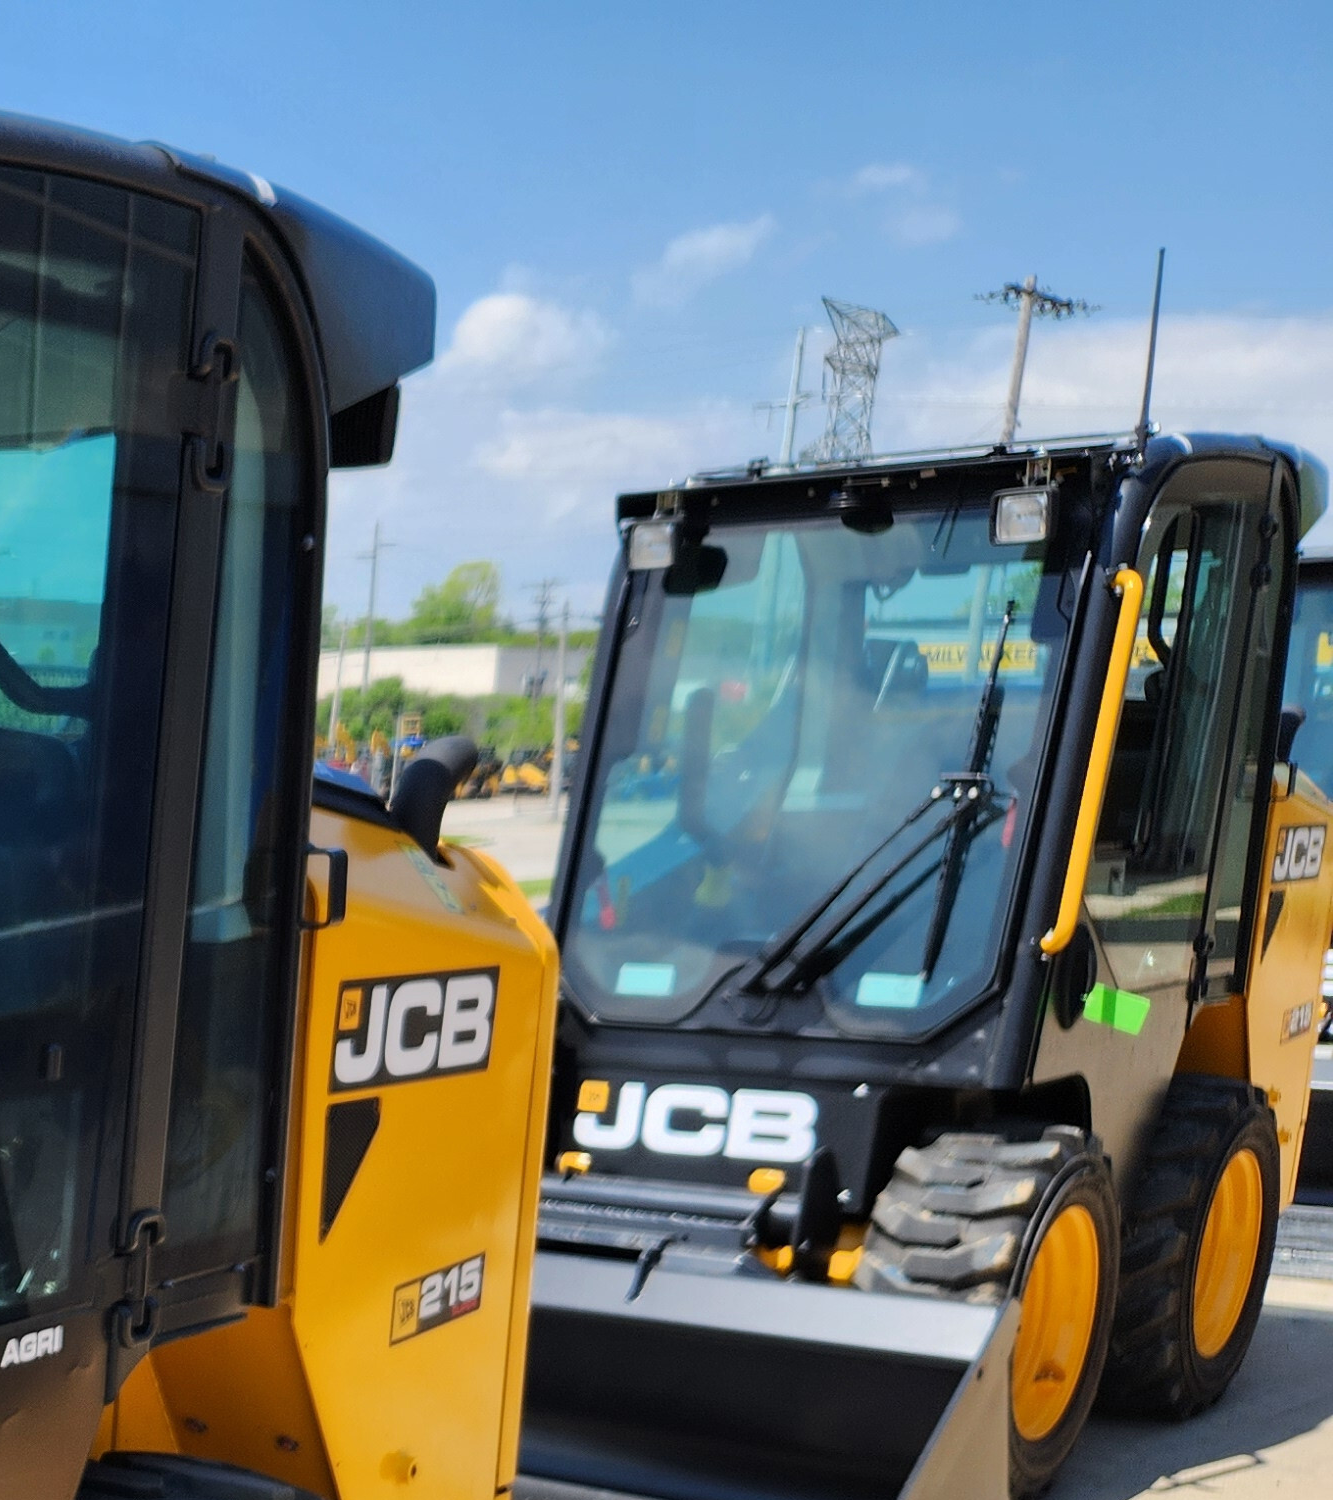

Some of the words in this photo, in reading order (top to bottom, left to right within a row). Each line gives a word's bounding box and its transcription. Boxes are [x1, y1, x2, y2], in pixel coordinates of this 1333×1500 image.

[1273, 826, 1326, 882] JCB
[334, 974, 494, 1084] JCB
[573, 1081, 819, 1163] JCB
[419, 1256, 481, 1319] 215
[0, 1324, 64, 1368] AGRI
